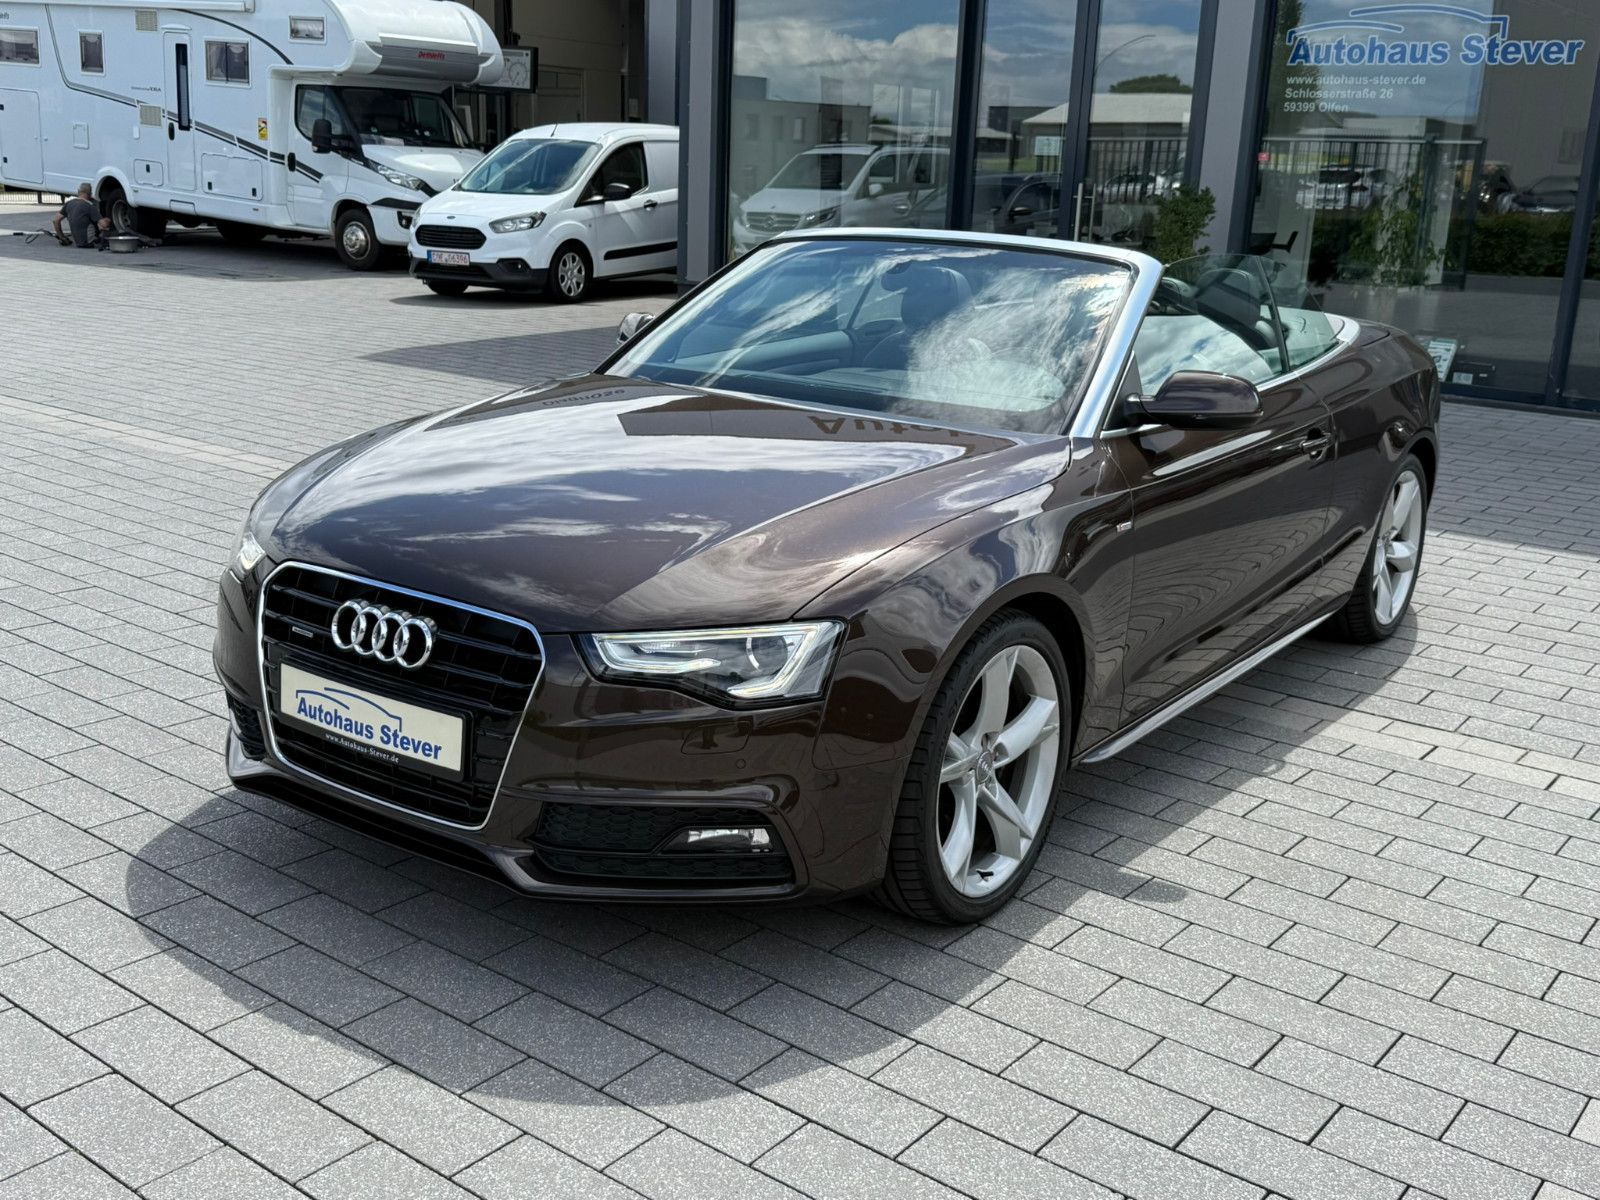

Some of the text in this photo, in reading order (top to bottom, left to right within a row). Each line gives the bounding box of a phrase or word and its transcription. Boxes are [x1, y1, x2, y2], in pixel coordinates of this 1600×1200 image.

[1287, 33, 1585, 66] Autohaus Stever
[1286, 74, 1426, 85] www.autohaus-stever.de
[1285, 88, 1394, 99] Schlosserstraße 26
[1283, 102, 1348, 112] 59399 Olfen
[296, 697, 442, 760] Autohaus Stever
